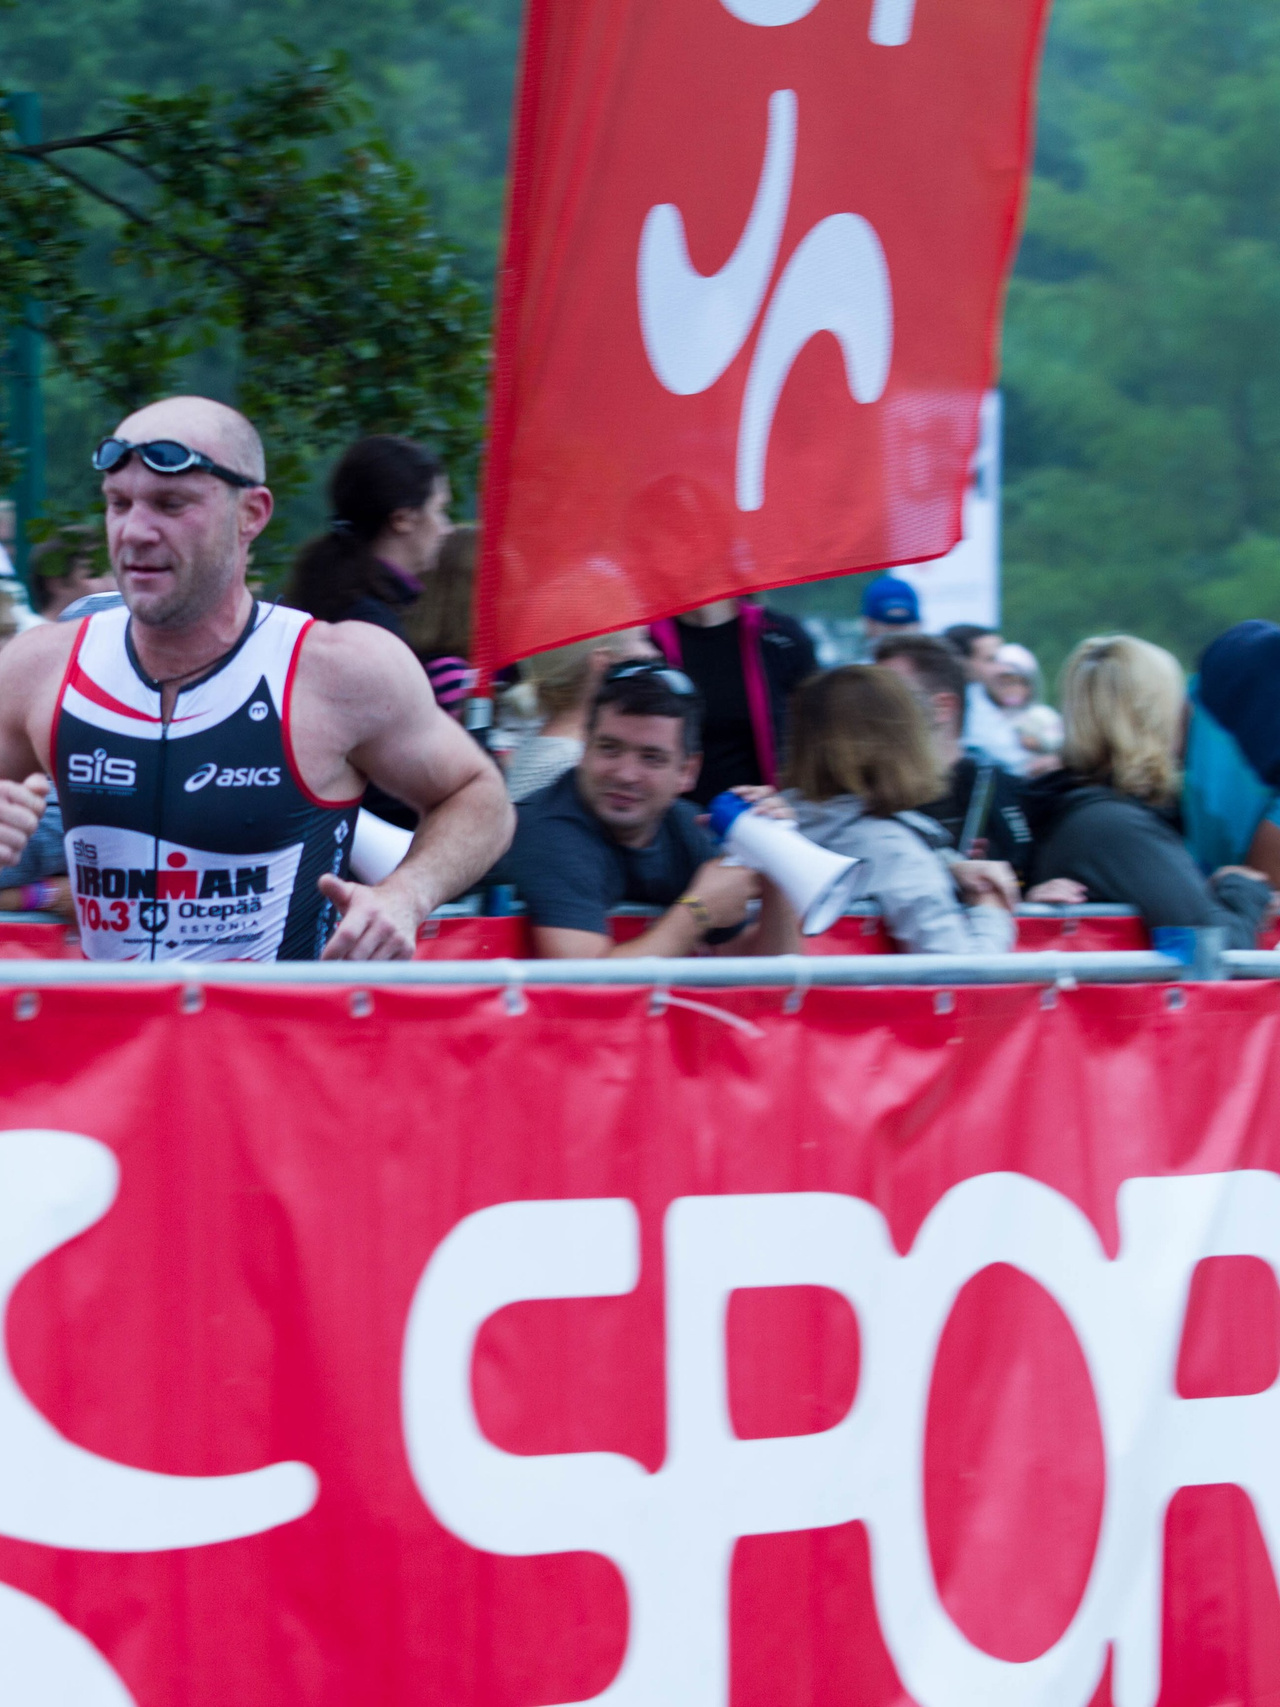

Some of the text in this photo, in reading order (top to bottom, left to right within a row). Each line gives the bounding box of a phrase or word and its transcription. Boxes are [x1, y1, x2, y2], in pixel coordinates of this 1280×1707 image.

[76, 853, 270, 900] IRONMAN
[78, 896, 130, 932] 70.3
[179, 898, 262, 921] Otepää
[180, 919, 259, 933] ESTONIA
